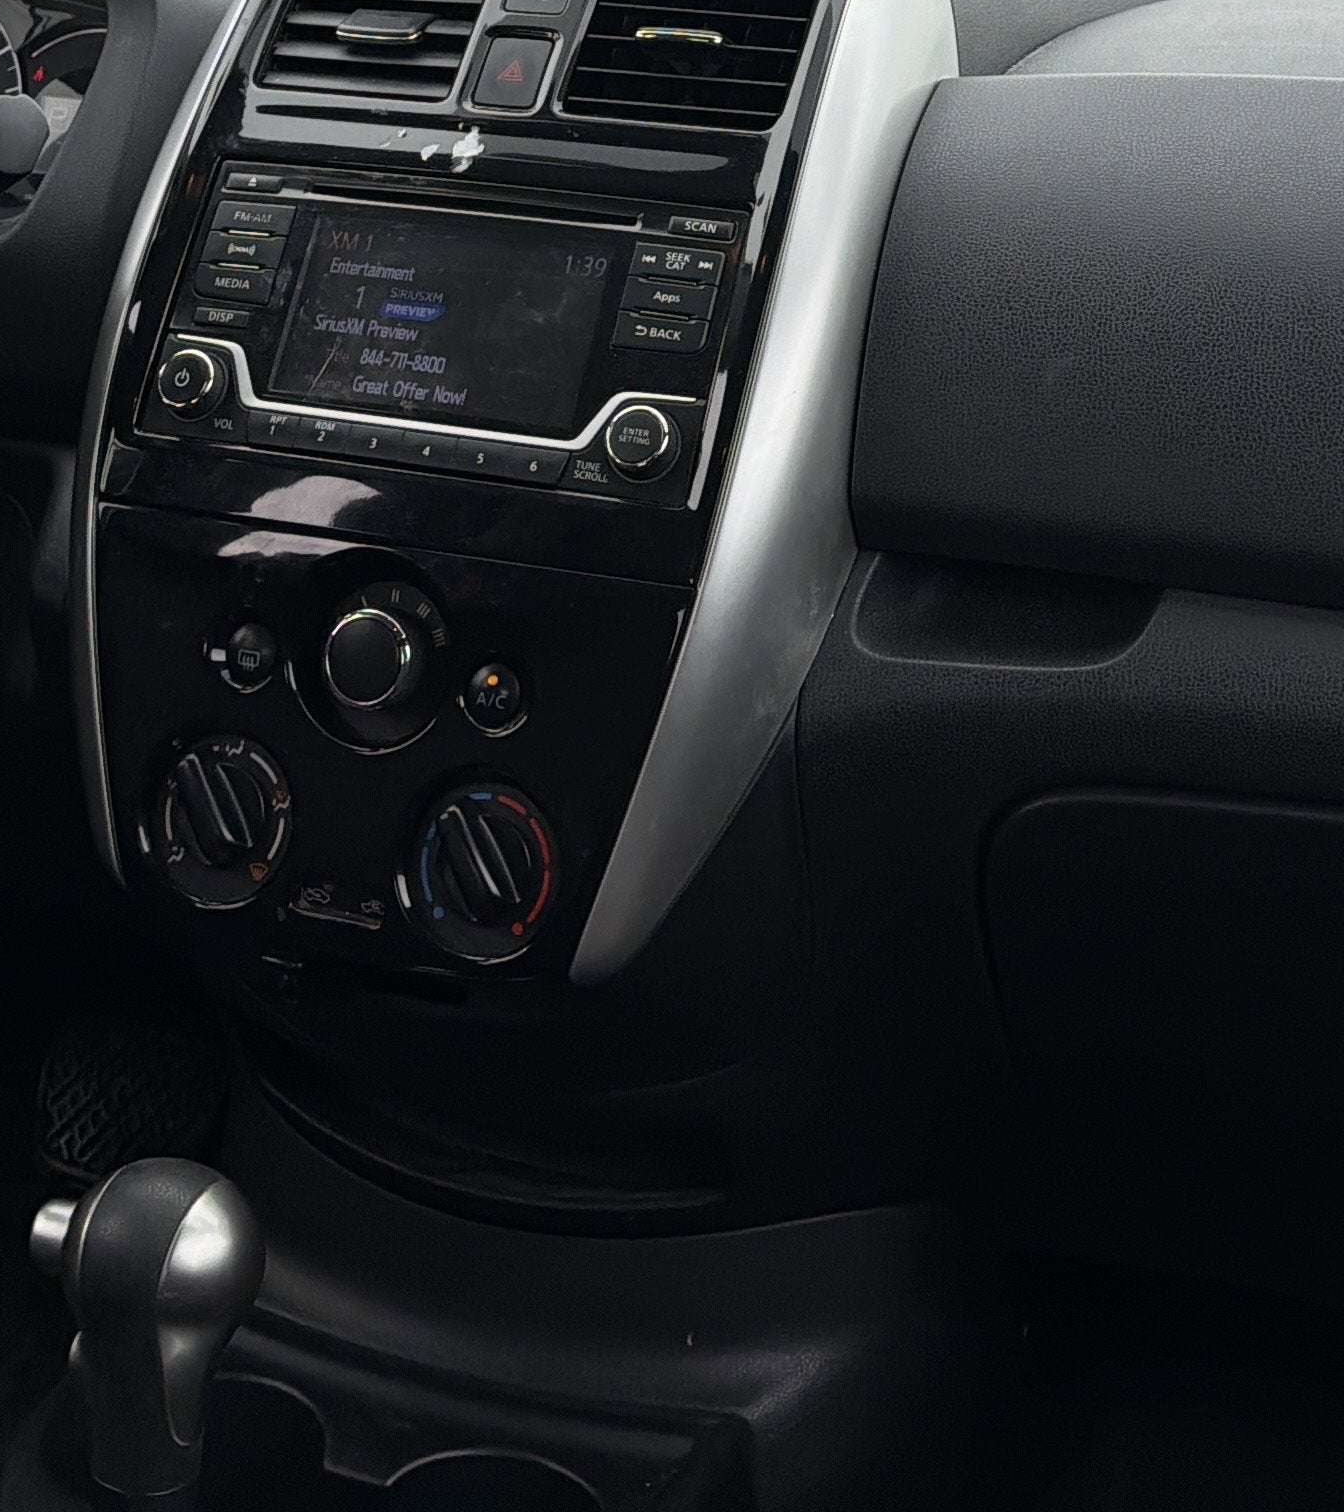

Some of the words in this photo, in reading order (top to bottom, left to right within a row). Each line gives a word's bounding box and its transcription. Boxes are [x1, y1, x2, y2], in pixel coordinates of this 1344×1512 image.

[684, 220, 718, 234] SCAN
[328, 230, 360, 250] XM
[366, 234, 374, 252] 1
[665, 251, 692, 263] SEEK
[329, 257, 416, 282] Entertainment
[565, 255, 607, 278] 1:39
[665, 260, 686, 271] CAT
[214, 276, 250, 289] MEDIA
[356, 286, 366, 310] 1
[653, 291, 681, 303] Apps
[208, 311, 234, 323] DISP
[313, 314, 365, 336] SiriusXM
[366, 320, 418, 342] Preview
[649, 327, 682, 341] BACK
[359, 347, 447, 374] 844-711-8800
[352, 375, 389, 396] Great
[392, 380, 430, 401] Offer
[433, 386, 468, 406] Now!
[214, 417, 234, 431] VOL
[269, 415, 288, 425] RPT
[315, 420, 336, 432] RDM
[270, 424, 276, 436] 1
[623, 426, 650, 437] ENTER
[317, 431, 327, 442] 2
[618, 434, 650, 446] SETTING
[368, 438, 378, 449] 3
[421, 445, 432, 457] 4
[476, 453, 486, 464] 5
[529, 460, 538, 472] 6
[575, 459, 602, 473] TUNE
[572, 469, 609, 484] SCROLL
[476, 691, 507, 710] A/C
